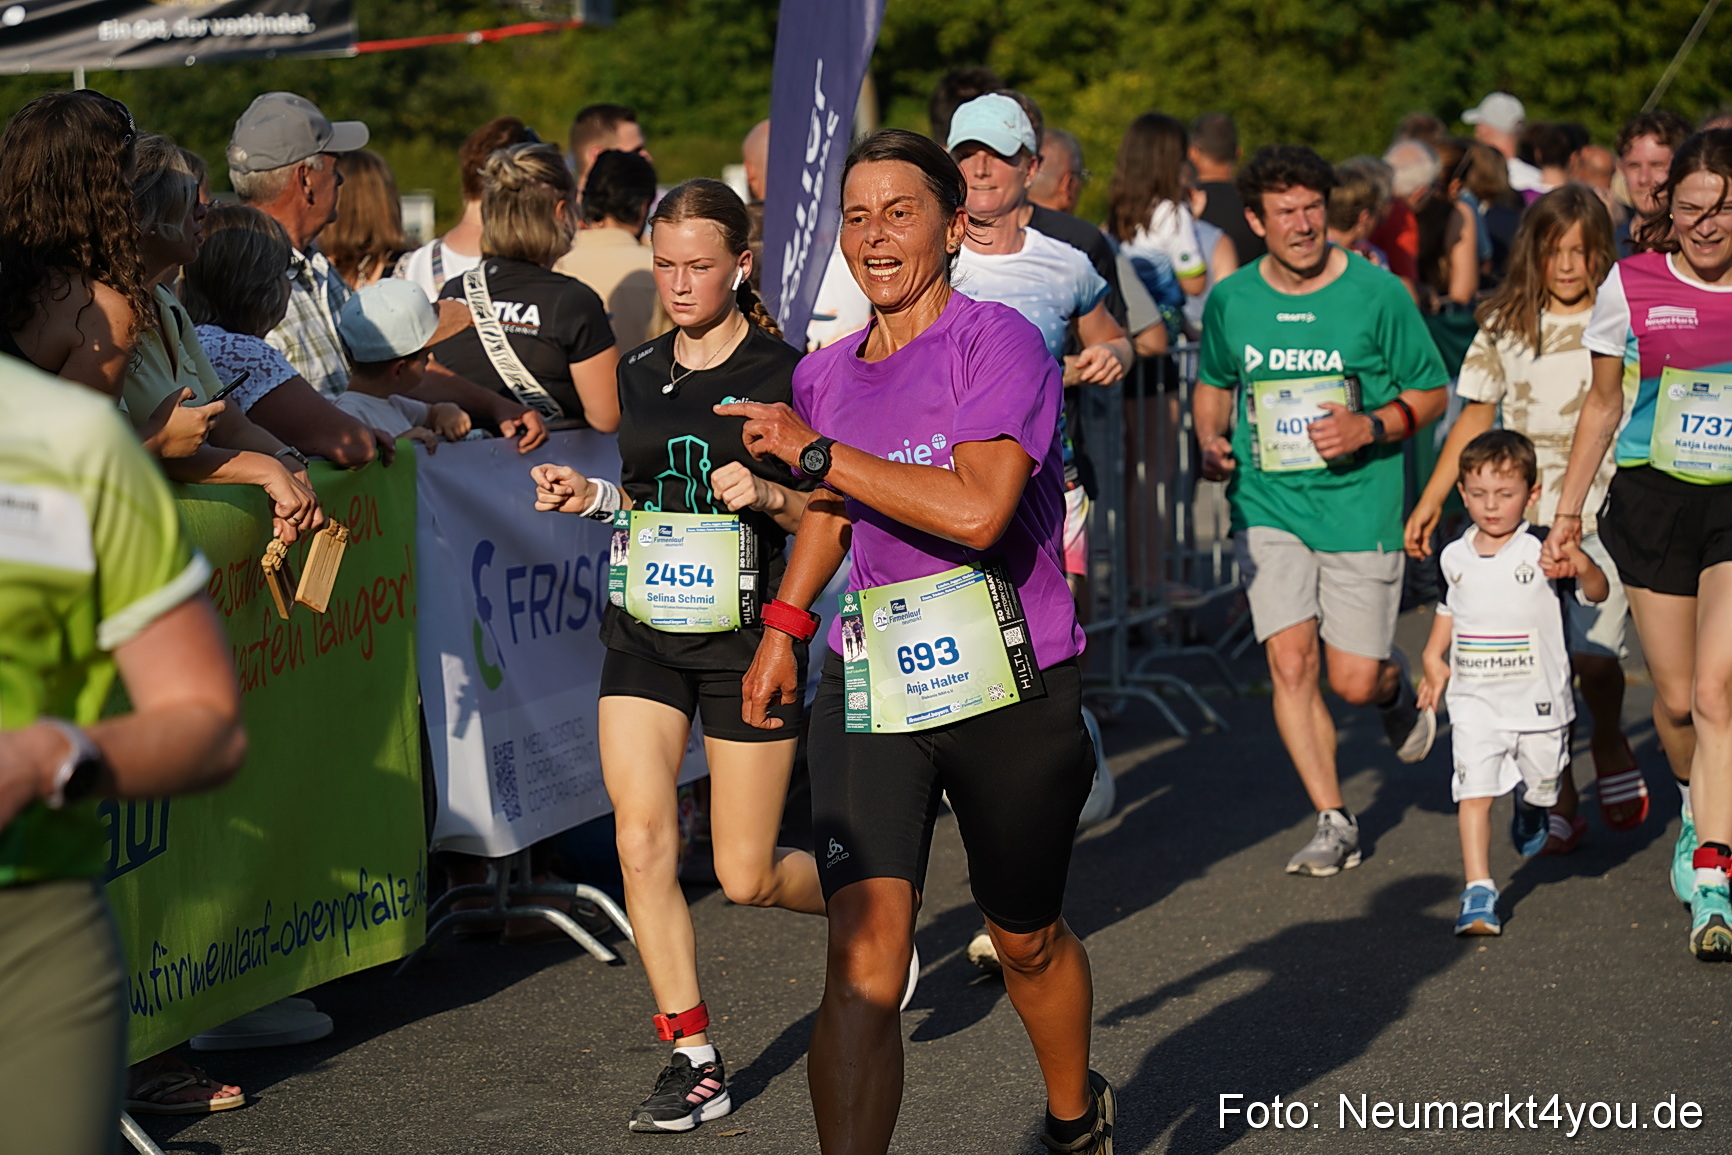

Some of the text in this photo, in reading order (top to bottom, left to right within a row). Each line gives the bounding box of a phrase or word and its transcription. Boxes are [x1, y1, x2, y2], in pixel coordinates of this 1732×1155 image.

[1268, 348, 1344, 372] DEKRA
[887, 439, 933, 466] nie
[1703, 442, 1732, 451] Lechn
[645, 562, 715, 588] 2454
[985, 568, 1000, 602] RABATT
[647, 592, 715, 605] Selina Schmid
[742, 593, 752, 624] HILTL
[843, 603, 859, 613] AOK
[889, 608, 921, 624] Firmenlauf
[997, 609, 1006, 622] 20
[897, 636, 960, 675] 693
[1013, 648, 1032, 689] HILTL
[906, 681, 929, 695] Anja
[930, 671, 970, 689] Halter
[826, 852, 850, 869] odlo
